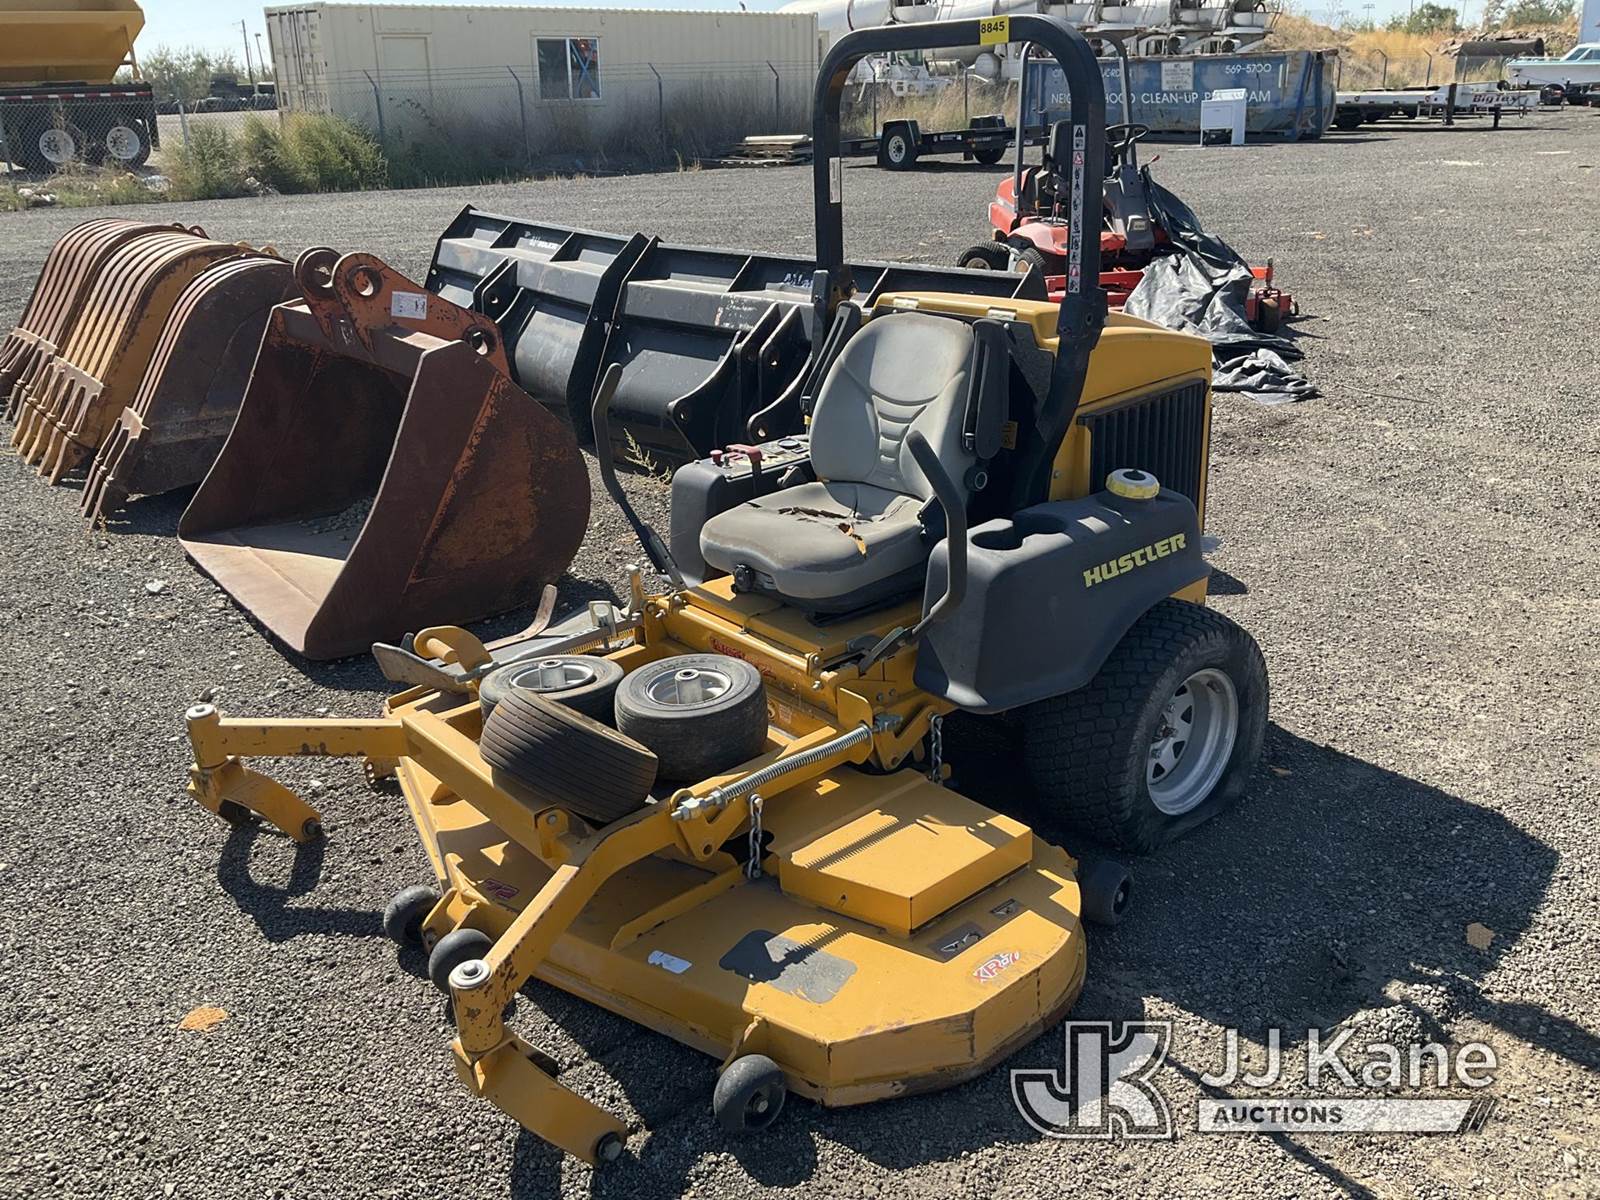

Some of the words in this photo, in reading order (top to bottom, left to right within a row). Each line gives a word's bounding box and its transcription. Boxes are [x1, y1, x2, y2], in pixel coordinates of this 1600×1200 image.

[981, 21, 1005, 34] 8845
[1225, 62, 1272, 75] 569-5700
[1141, 91, 1199, 104] CLEAN-UP
[1083, 532, 1186, 588] HUSTLER
